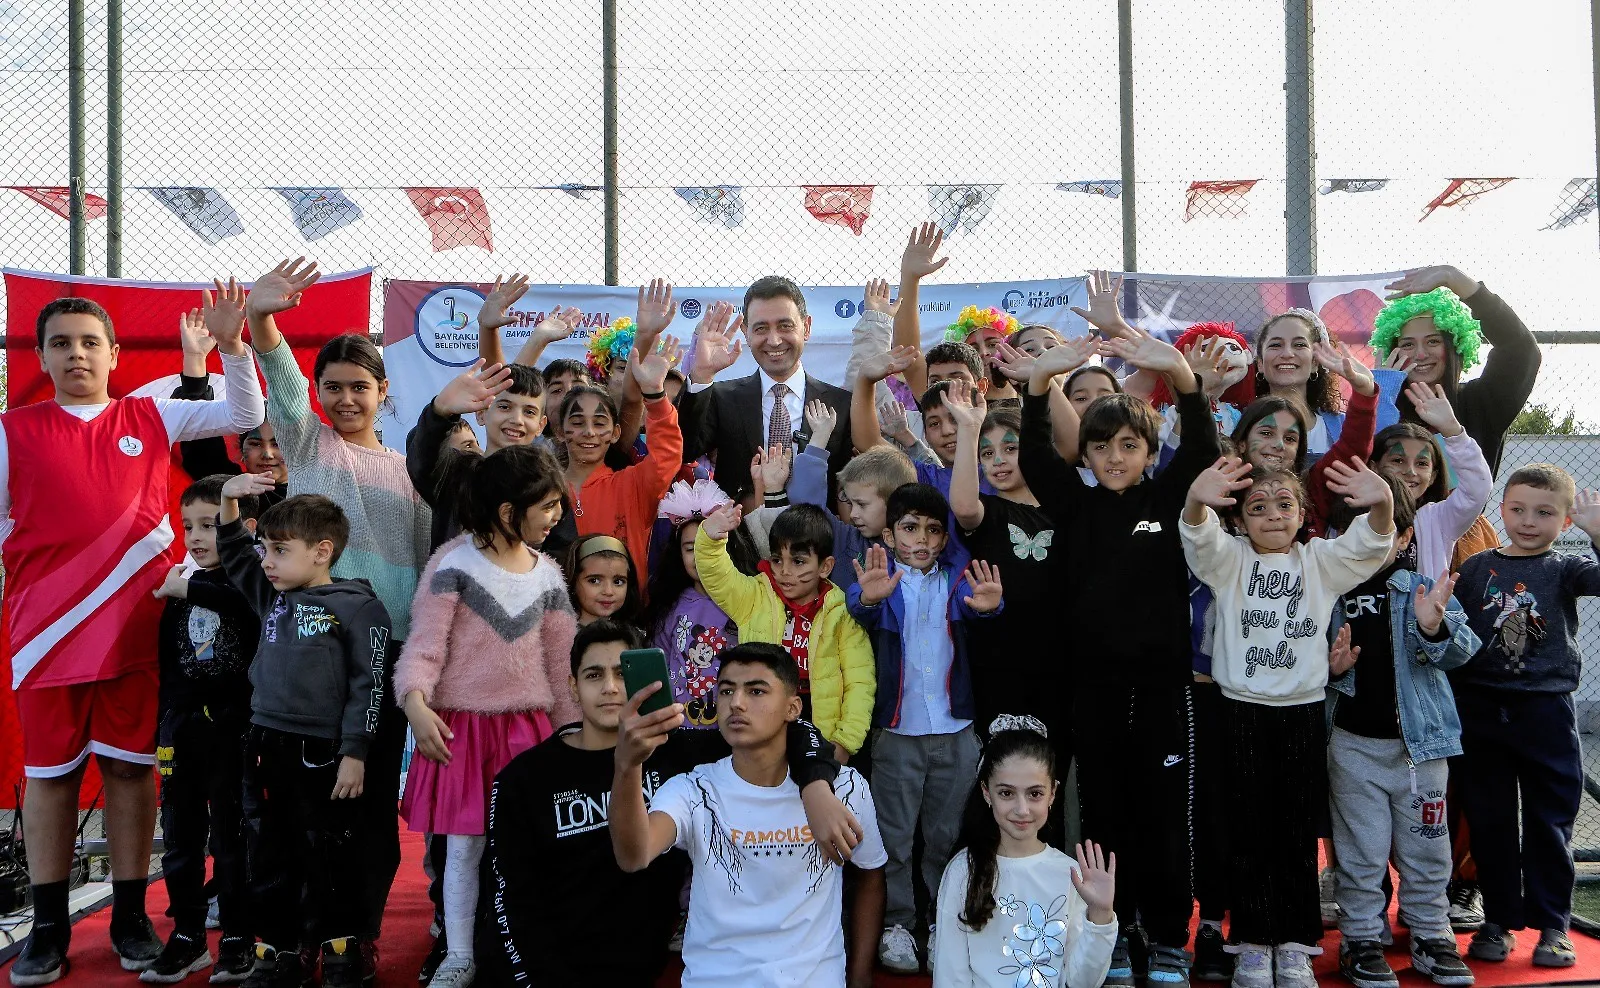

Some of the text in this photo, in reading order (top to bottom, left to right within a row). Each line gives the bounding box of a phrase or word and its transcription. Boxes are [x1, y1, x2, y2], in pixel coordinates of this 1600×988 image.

[1028, 297, 1043, 308] 477
[1057, 295, 1069, 305] 00
[434, 332, 479, 341] BAYRAKLI
[435, 341, 479, 350] BELEDİYESİ
[1247, 560, 1304, 619] hey
[296, 603, 325, 614] READY
[297, 620, 332, 640] NOW
[1241, 608, 1280, 639] you
[1245, 640, 1297, 678] girls
[365, 626, 389, 733] NEVER
[555, 771, 653, 832] LONN
[1411, 795, 1426, 811] NEW
[1422, 800, 1445, 825] 67
[730, 824, 816, 846] FAMOUS
